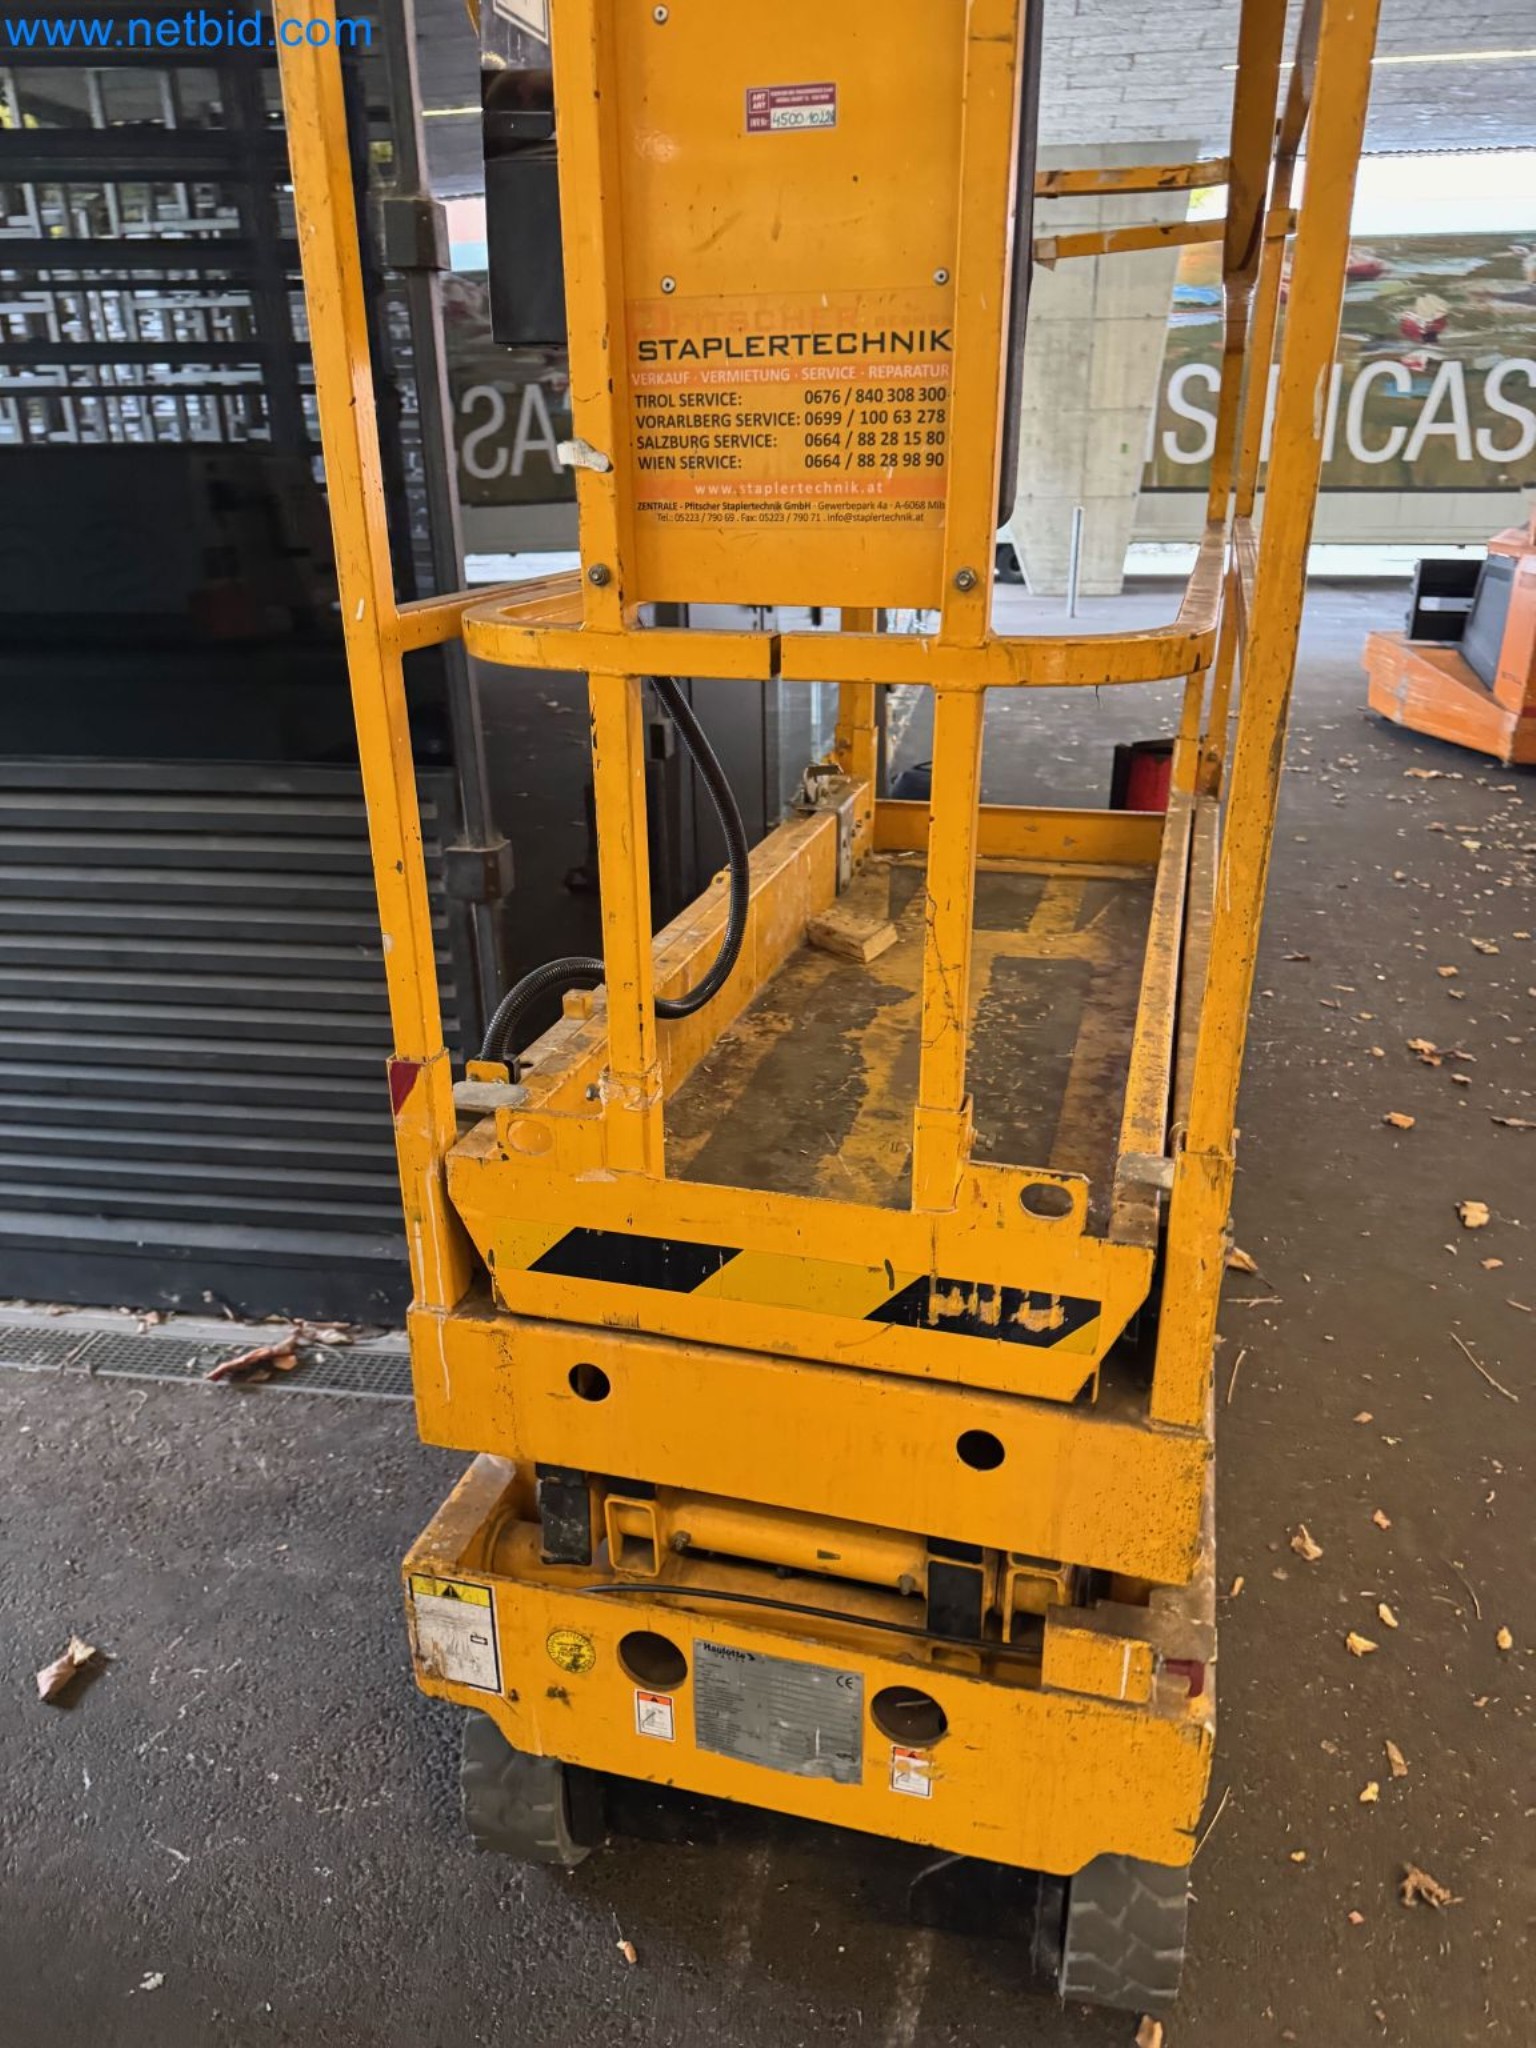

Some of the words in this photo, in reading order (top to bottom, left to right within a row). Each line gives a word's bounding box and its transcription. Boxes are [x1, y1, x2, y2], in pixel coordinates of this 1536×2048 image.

[638, 329, 953, 361] STAPLERTECHNIK
[631, 371, 690, 386] VERKAUF
[701, 368, 790, 384] VERMIETUNG
[801, 365, 856, 380] SERVICE
[868, 363, 949, 378] REPARATUR
[635, 394, 675, 408] TIROL
[679, 392, 742, 407] SERVICE:
[804, 390, 841, 404] 0676
[855, 388, 883, 403] 840
[887, 388, 914, 402] 308
[919, 387, 946, 402] 300
[636, 414, 732, 429] VORARLBERG
[735, 412, 800, 427] SERVICE:
[804, 411, 841, 426] 0699
[860, 410, 888, 424] 100
[893, 410, 912, 423] 63
[917, 409, 945, 423] 278
[636, 435, 710, 449] SALZBURG
[714, 434, 777, 448] SERVICE:
[804, 433, 840, 447] 0664
[857, 432, 876, 446] 88
[880, 432, 898, 445] 28
[904, 432, 921, 445] 15
[926, 431, 945, 445] 80
[638, 456, 676, 470] WIEN
[680, 455, 742, 469] SERVICE:
[804, 454, 840, 468] 0664
[857, 453, 875, 467] 88
[880, 453, 898, 467] 28
[903, 453, 921, 466] 98
[926, 452, 944, 466] 90
[694, 480, 883, 496] www.staplertechnik.at
[637, 502, 677, 511] ZENTRALE
[722, 501, 782, 512] Staplertechnik
[784, 502, 811, 510] GmbH
[818, 501, 873, 512] Gewerbepark
